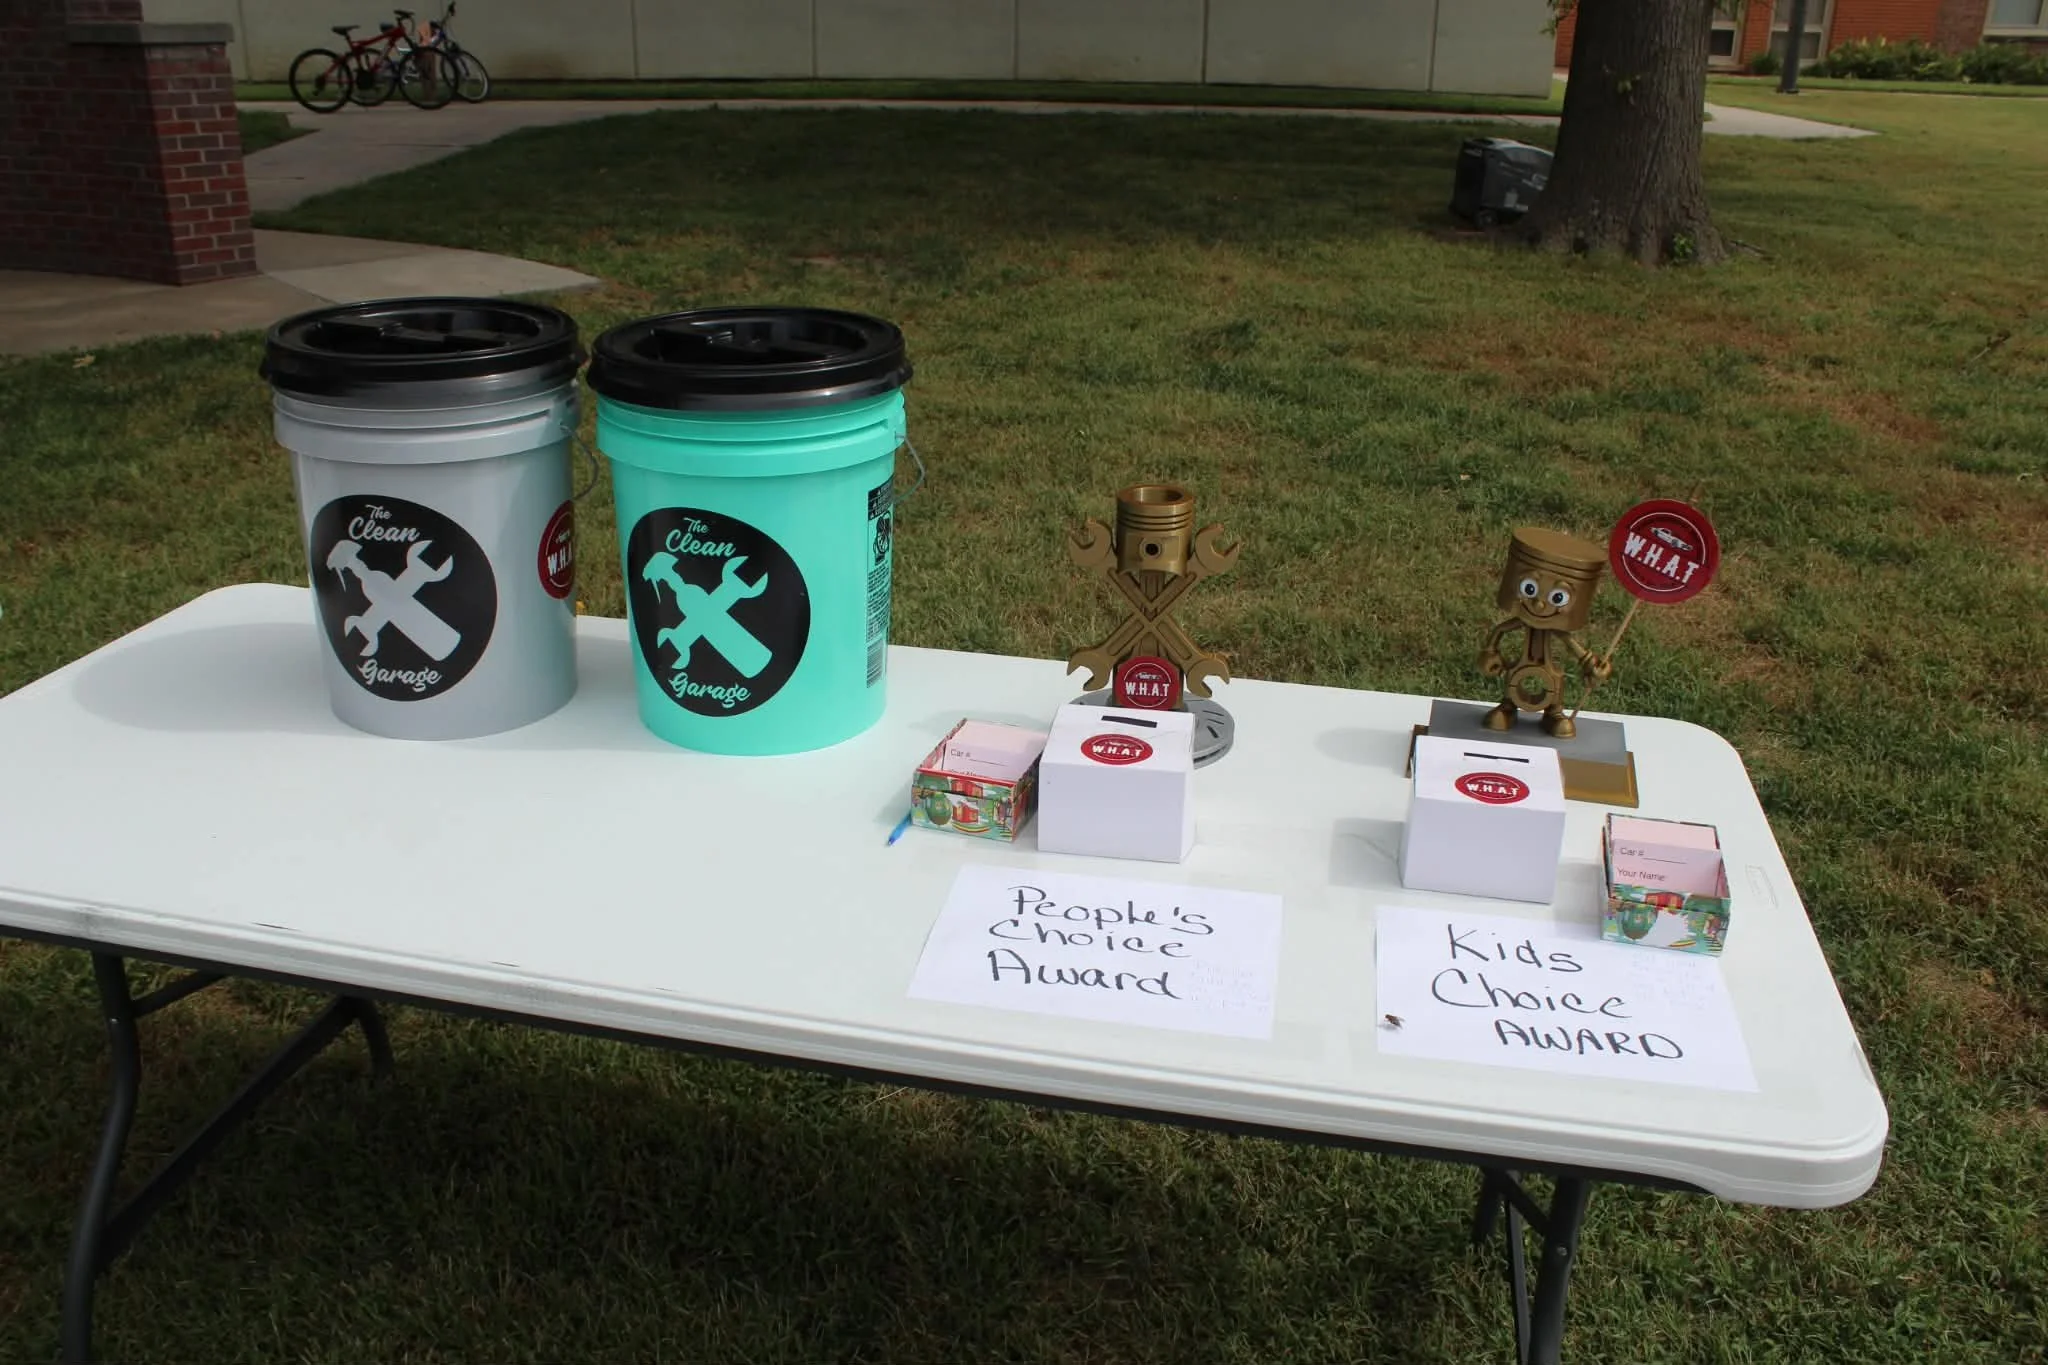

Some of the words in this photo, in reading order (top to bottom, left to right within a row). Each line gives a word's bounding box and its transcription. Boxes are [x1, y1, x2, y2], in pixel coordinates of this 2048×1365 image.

[349, 515, 420, 542] Clean
[365, 503, 392, 520] The
[683, 517, 709, 534] The
[665, 529, 737, 557] Clean
[358, 659, 443, 692] Garage
[668, 672, 751, 708] Garage
[1620, 847, 1638, 856] Car
[1616, 867, 1637, 878] Your
[1007, 885, 1214, 936] People's
[988, 918, 1192, 958] Choice
[1448, 924, 1583, 972] Kids
[987, 948, 1184, 1000] Award
[1432, 967, 1632, 1018] Choice
[1494, 1018, 1684, 1060] AWARD
